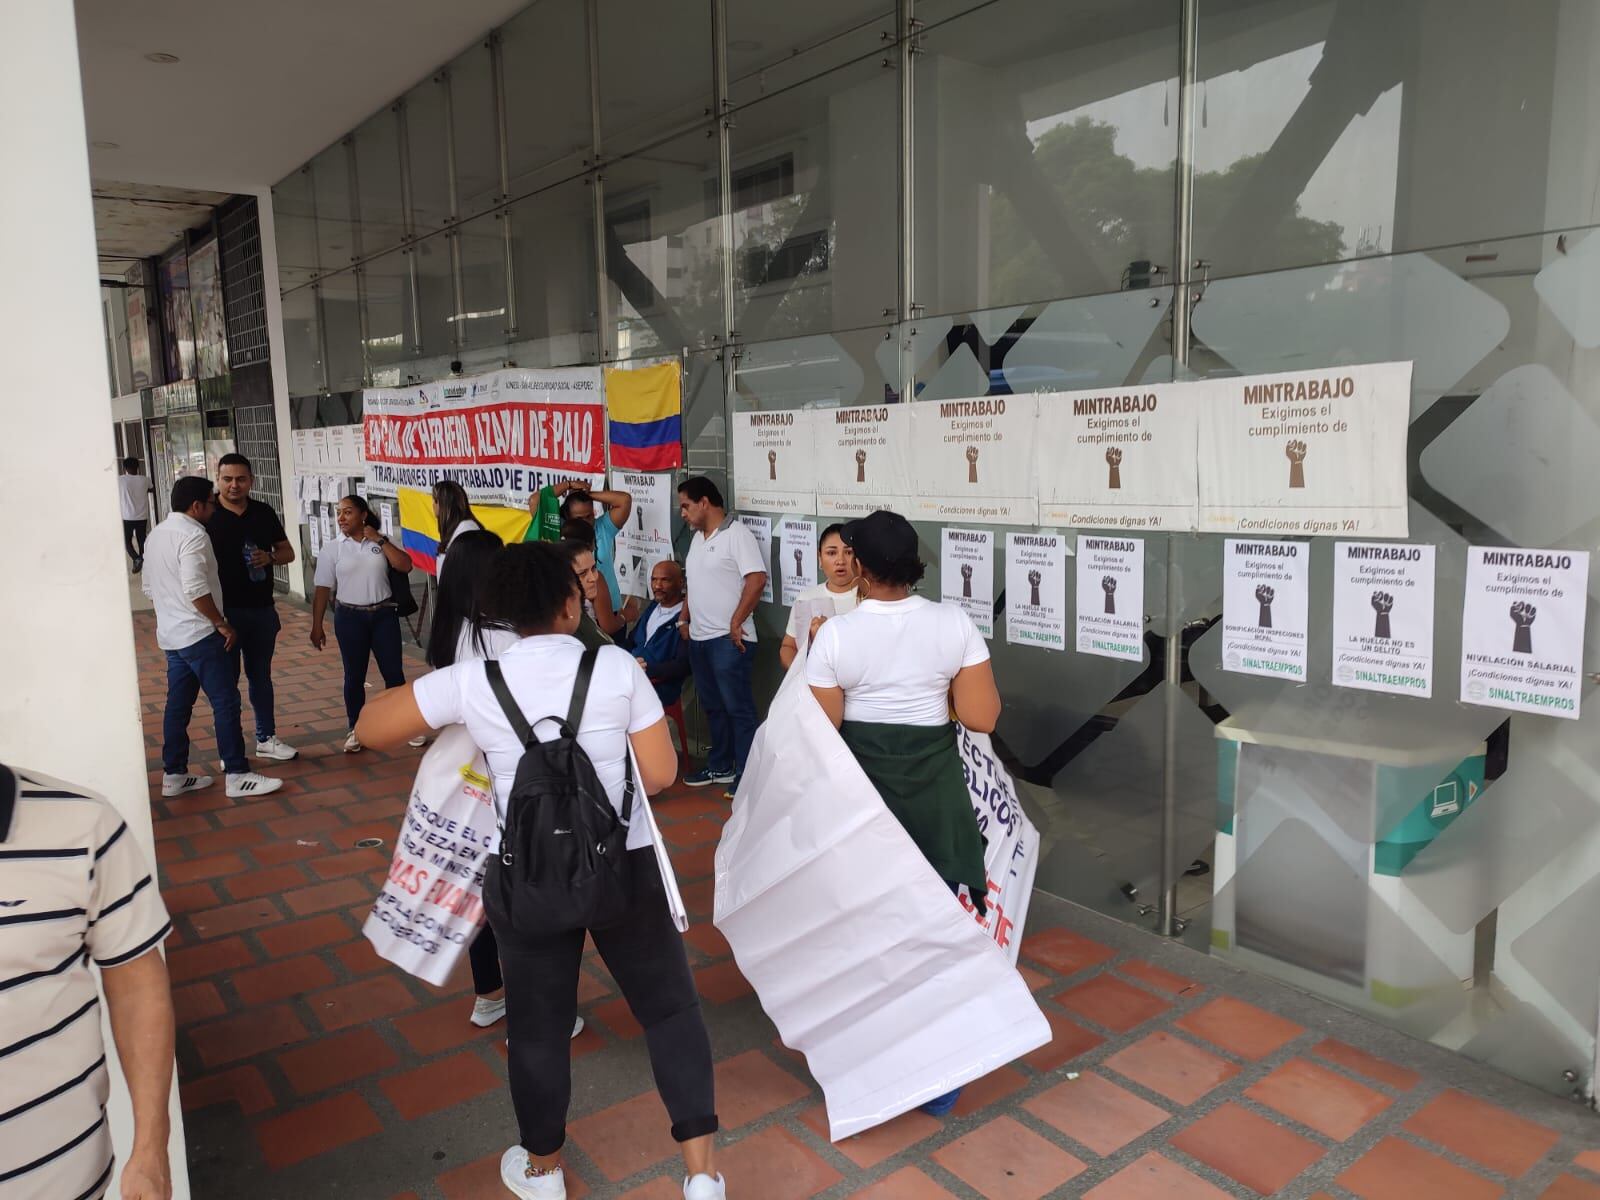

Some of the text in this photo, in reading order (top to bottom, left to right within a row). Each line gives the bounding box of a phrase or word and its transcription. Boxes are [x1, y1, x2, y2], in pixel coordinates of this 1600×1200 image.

[1243, 377, 1355, 405] MINTRABAJO
[940, 399, 1006, 418] MINTRABAJO
[1073, 394, 1157, 416] MINTRABAJO
[1262, 403, 1332, 421] Exigimos el
[750, 413, 794, 427] MINTRABAJO
[835, 408, 888, 424] MINTRABAJO
[951, 418, 993, 431] Exigimos el
[1087, 416, 1141, 431] Exigimos el
[1248, 420, 1348, 438] cumplimiento de
[529, 410, 548, 459] DE
[553, 410, 593, 464] PALO
[943, 431, 1003, 443] cumplimiento de
[1077, 431, 1153, 445] cumplimiento de
[429, 468, 440, 487] DE
[528, 471, 543, 493] DE
[624, 474, 655, 487] MINTRABAJO
[1069, 514, 1118, 526] ¡Condiciones
[1120, 515, 1146, 528] dignas
[1149, 516, 1162, 526] YA!
[1237, 518, 1360, 533] ¡Condiciones dignas YA!
[948, 531, 987, 543] MINTRABAJO
[1014, 536, 1057, 548] MINTRABAJO
[1086, 539, 1135, 553] MINTRABAJO
[1235, 543, 1297, 557] MINTRABAJO
[1348, 546, 1421, 561] MINTRABAJO
[1245, 560, 1276, 571] Exigimos
[1483, 552, 1572, 570] MINTRABAJO
[1238, 571, 1292, 581] cumplimiento de
[1359, 565, 1405, 576] Exigimos el
[1350, 576, 1416, 587] cumplimiento de
[1497, 572, 1551, 585] Exigimos el
[1486, 584, 1564, 598] cumplimiento de
[1113, 619, 1140, 628] SALARIAL
[1092, 640, 1140, 655] SINALTRAEMPROS
[1349, 635, 1415, 649] LA HUELGA NO ES
[1267, 647, 1289, 656] dignas
[1290, 649, 1302, 657] YA!
[1361, 645, 1400, 655] UN DELITO
[1242, 657, 1303, 676] SINALTRAEMPROS
[1338, 653, 1426, 671] ¡Condiciones dignas YA!
[1527, 658, 1577, 674] SALARIAL
[1355, 670, 1427, 689] SINALTRAEMPROS
[1468, 668, 1573, 689] ¡Condiciones dignas YA!
[1489, 687, 1575, 711] SINALTRAEMPROS
[461, 825, 478, 843] EL
